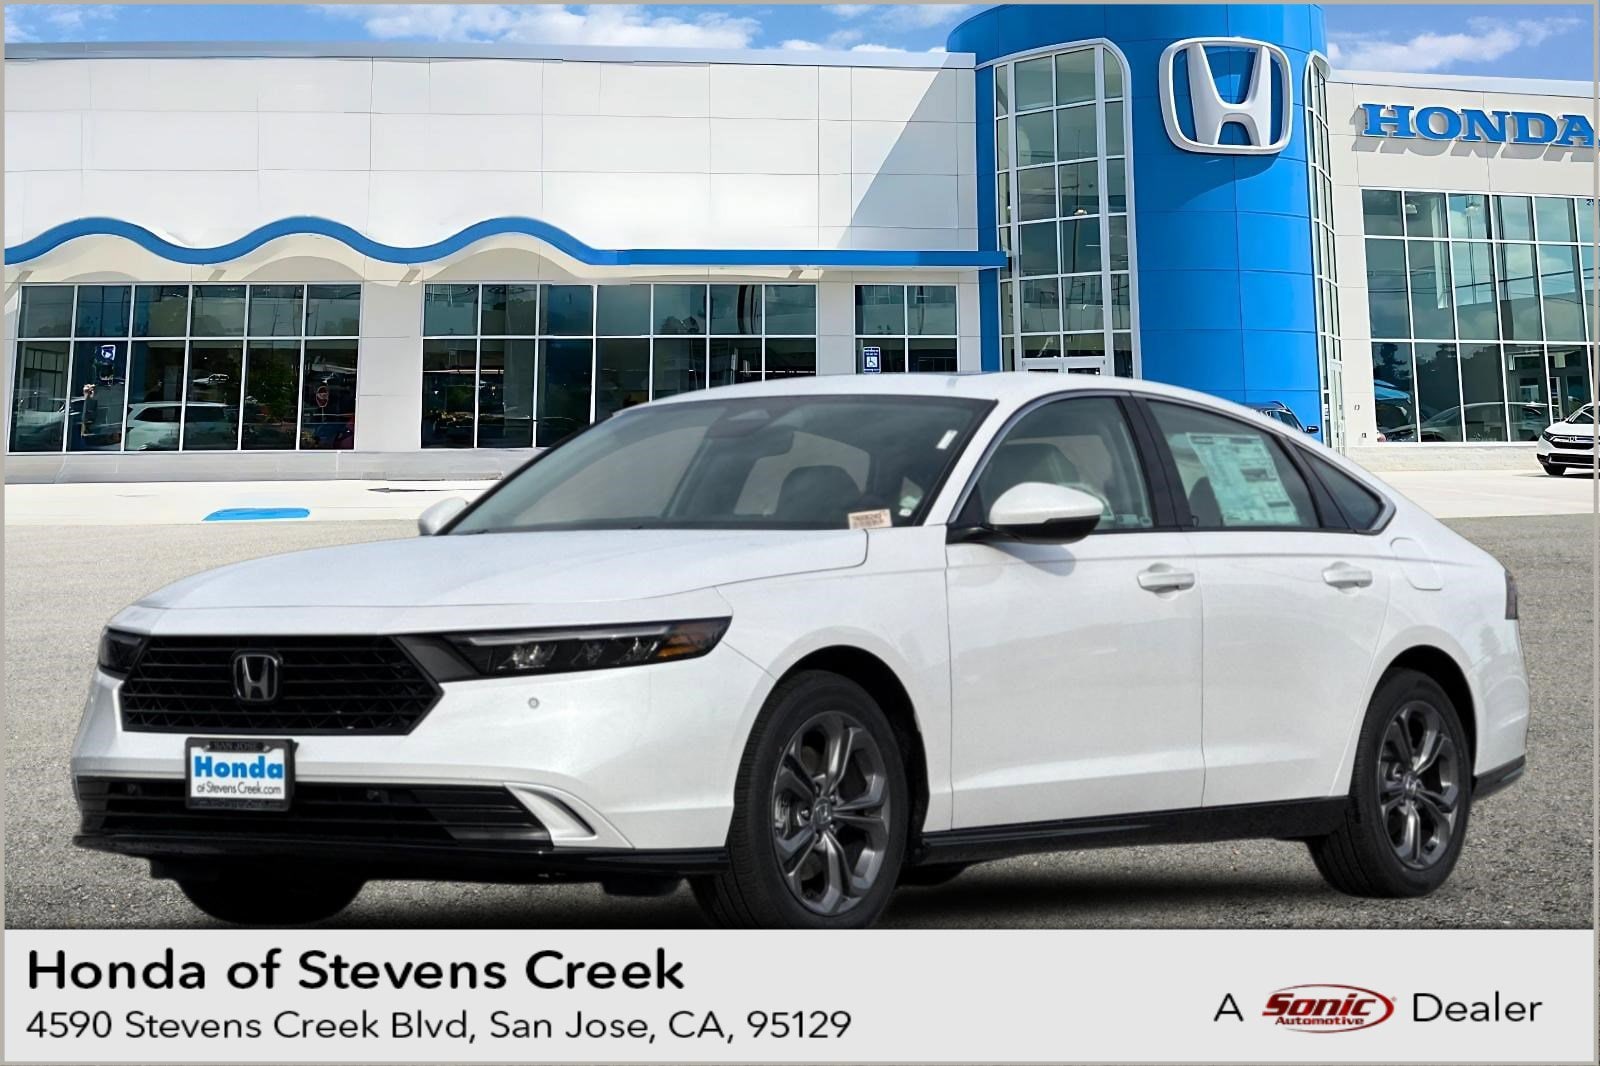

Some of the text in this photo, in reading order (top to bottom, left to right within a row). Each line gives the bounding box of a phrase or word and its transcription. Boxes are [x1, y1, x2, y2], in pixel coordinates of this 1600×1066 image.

[1362, 103, 1594, 147] HONDA
[194, 755, 284, 779] Honda
[197, 783, 206, 793] of
